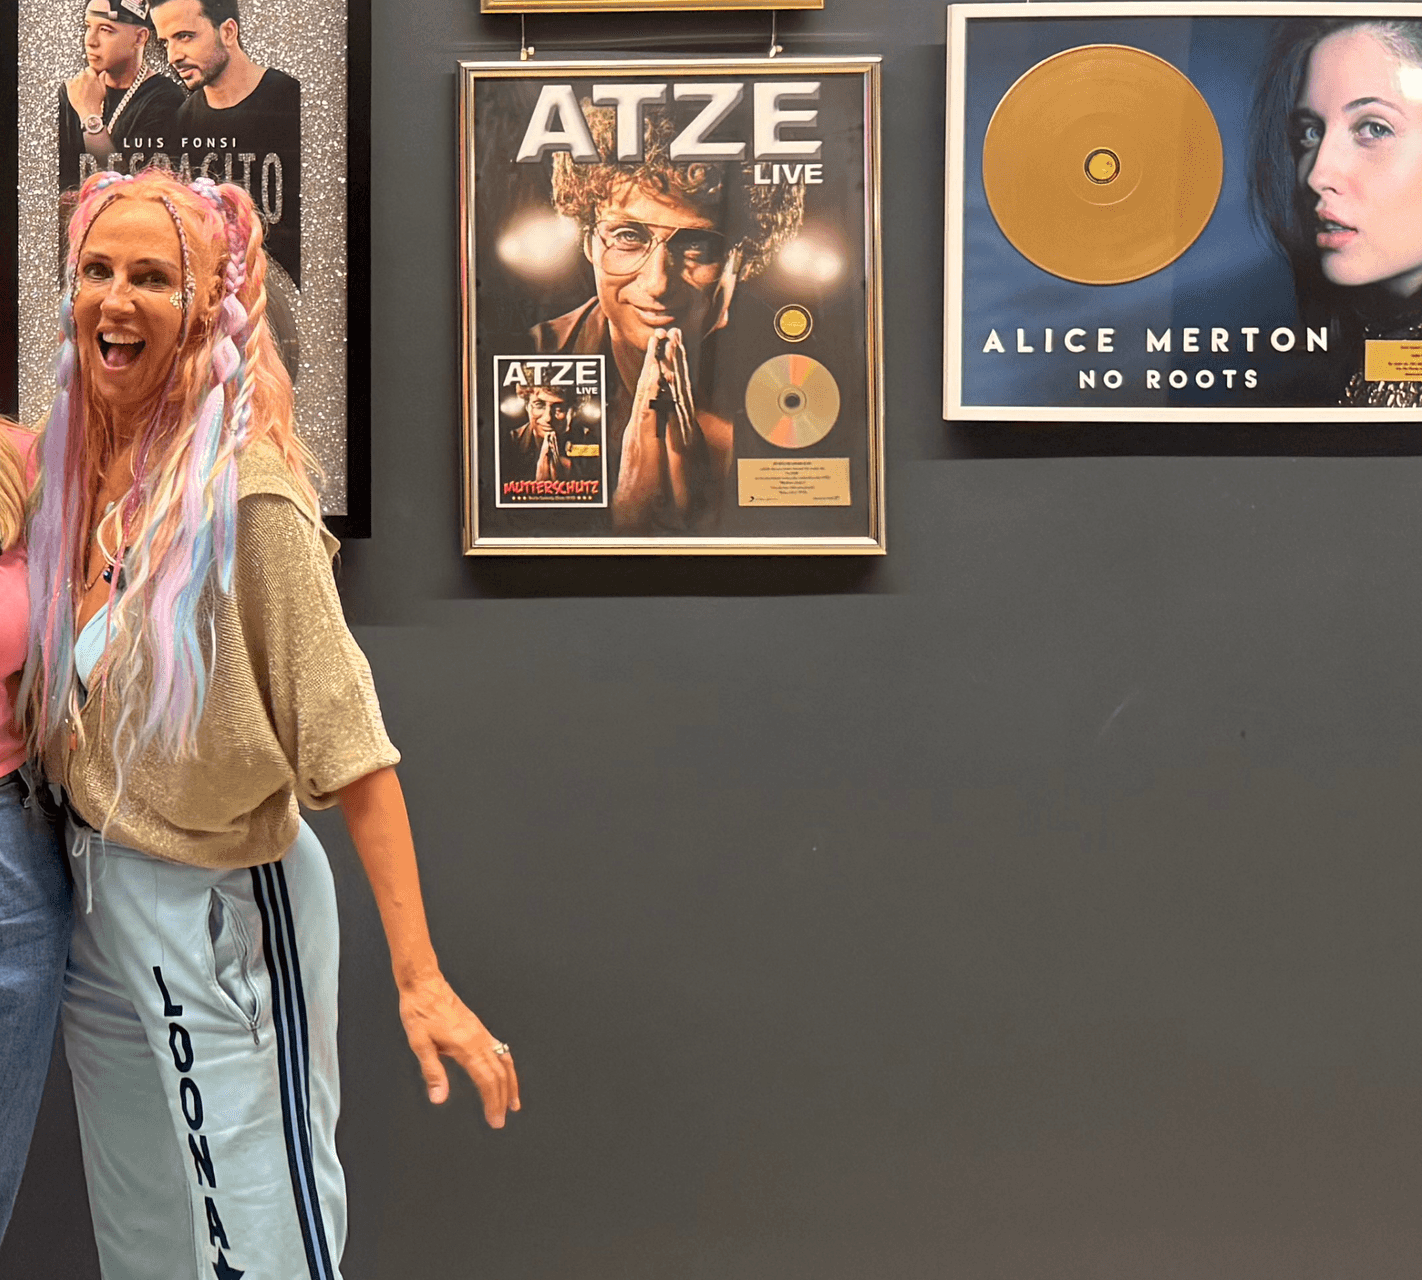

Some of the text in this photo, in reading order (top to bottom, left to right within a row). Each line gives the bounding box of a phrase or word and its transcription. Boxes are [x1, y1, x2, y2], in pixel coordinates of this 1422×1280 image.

[516, 82, 823, 163] ATZE
[122, 137, 237, 149] LUIS FONSI
[754, 163, 824, 185] LIVE
[982, 326, 1329, 353] ALICE MERTON
[502, 361, 598, 387] ATZE
[1078, 369, 1259, 389] NO ROOTS
[576, 387, 599, 395] LIVE
[503, 480, 600, 495] MUTTERSCHUTZ
[152, 965, 232, 1251] LOONA
